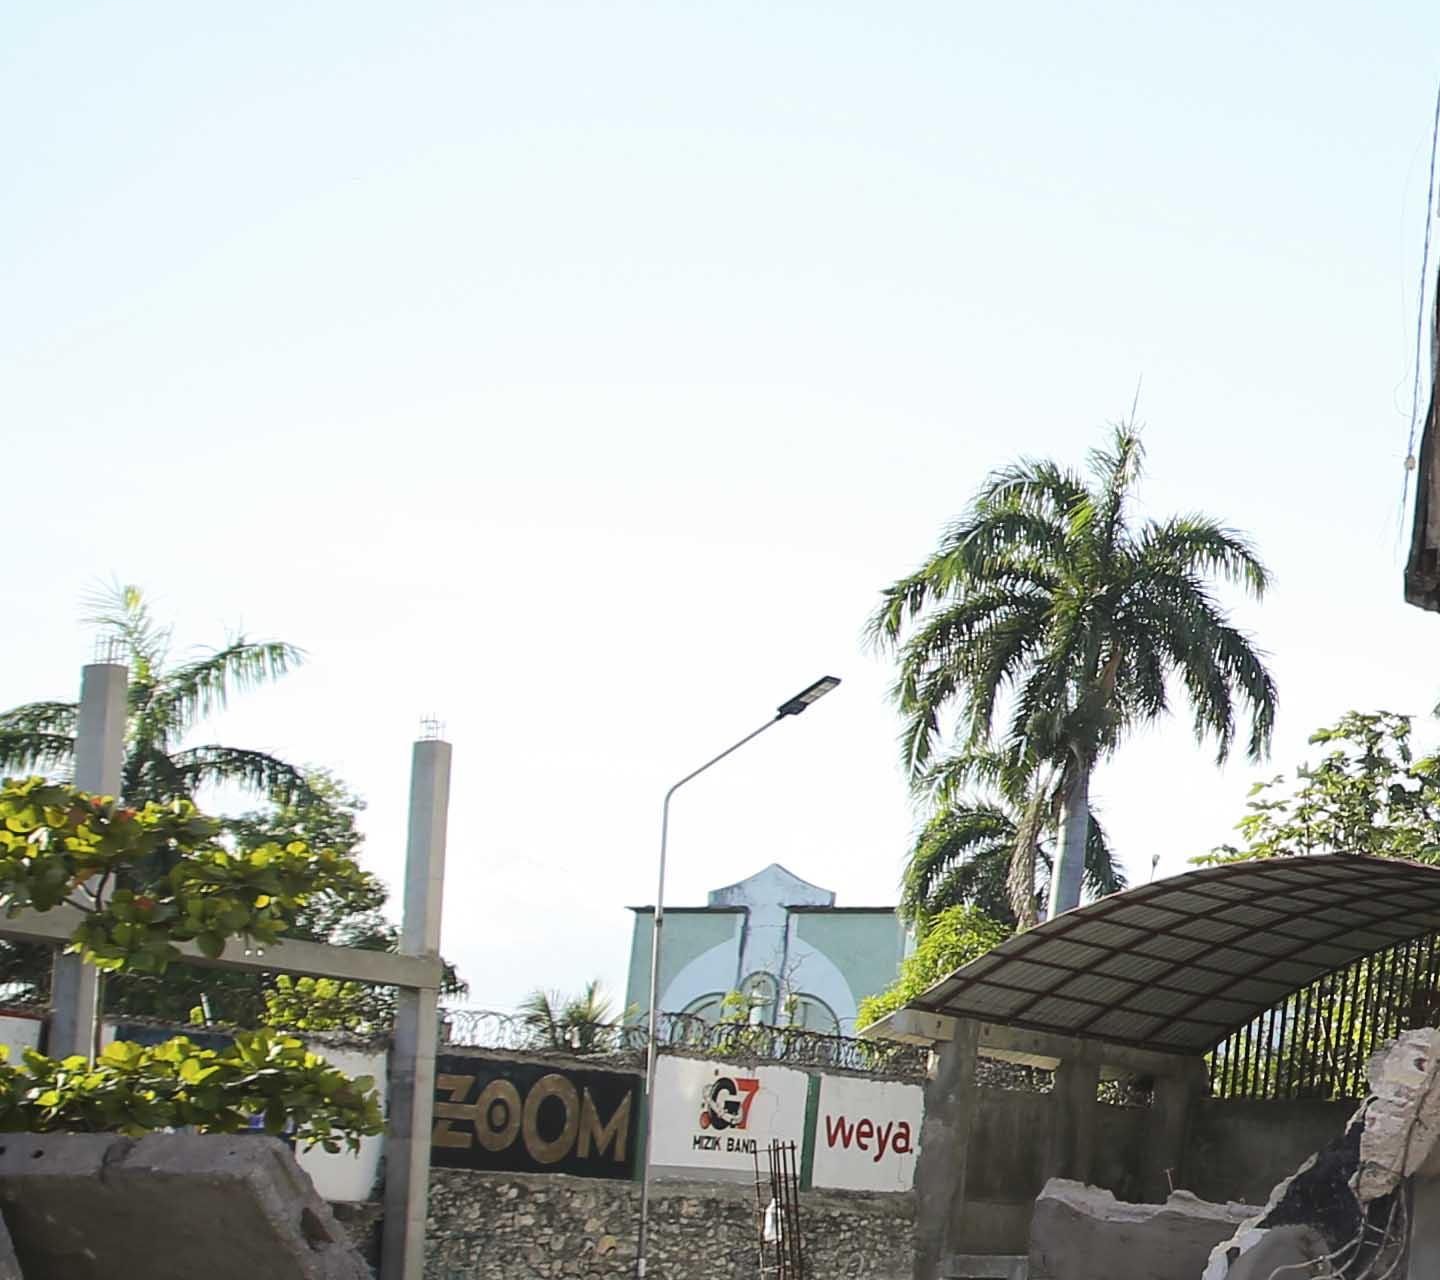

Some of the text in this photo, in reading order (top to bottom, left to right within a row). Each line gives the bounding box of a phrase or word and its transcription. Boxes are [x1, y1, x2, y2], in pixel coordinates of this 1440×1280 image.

[432, 1073, 632, 1164] ZOOM
[707, 1077, 760, 1131] G7
[692, 1135, 758, 1154] MIZIK BAND
